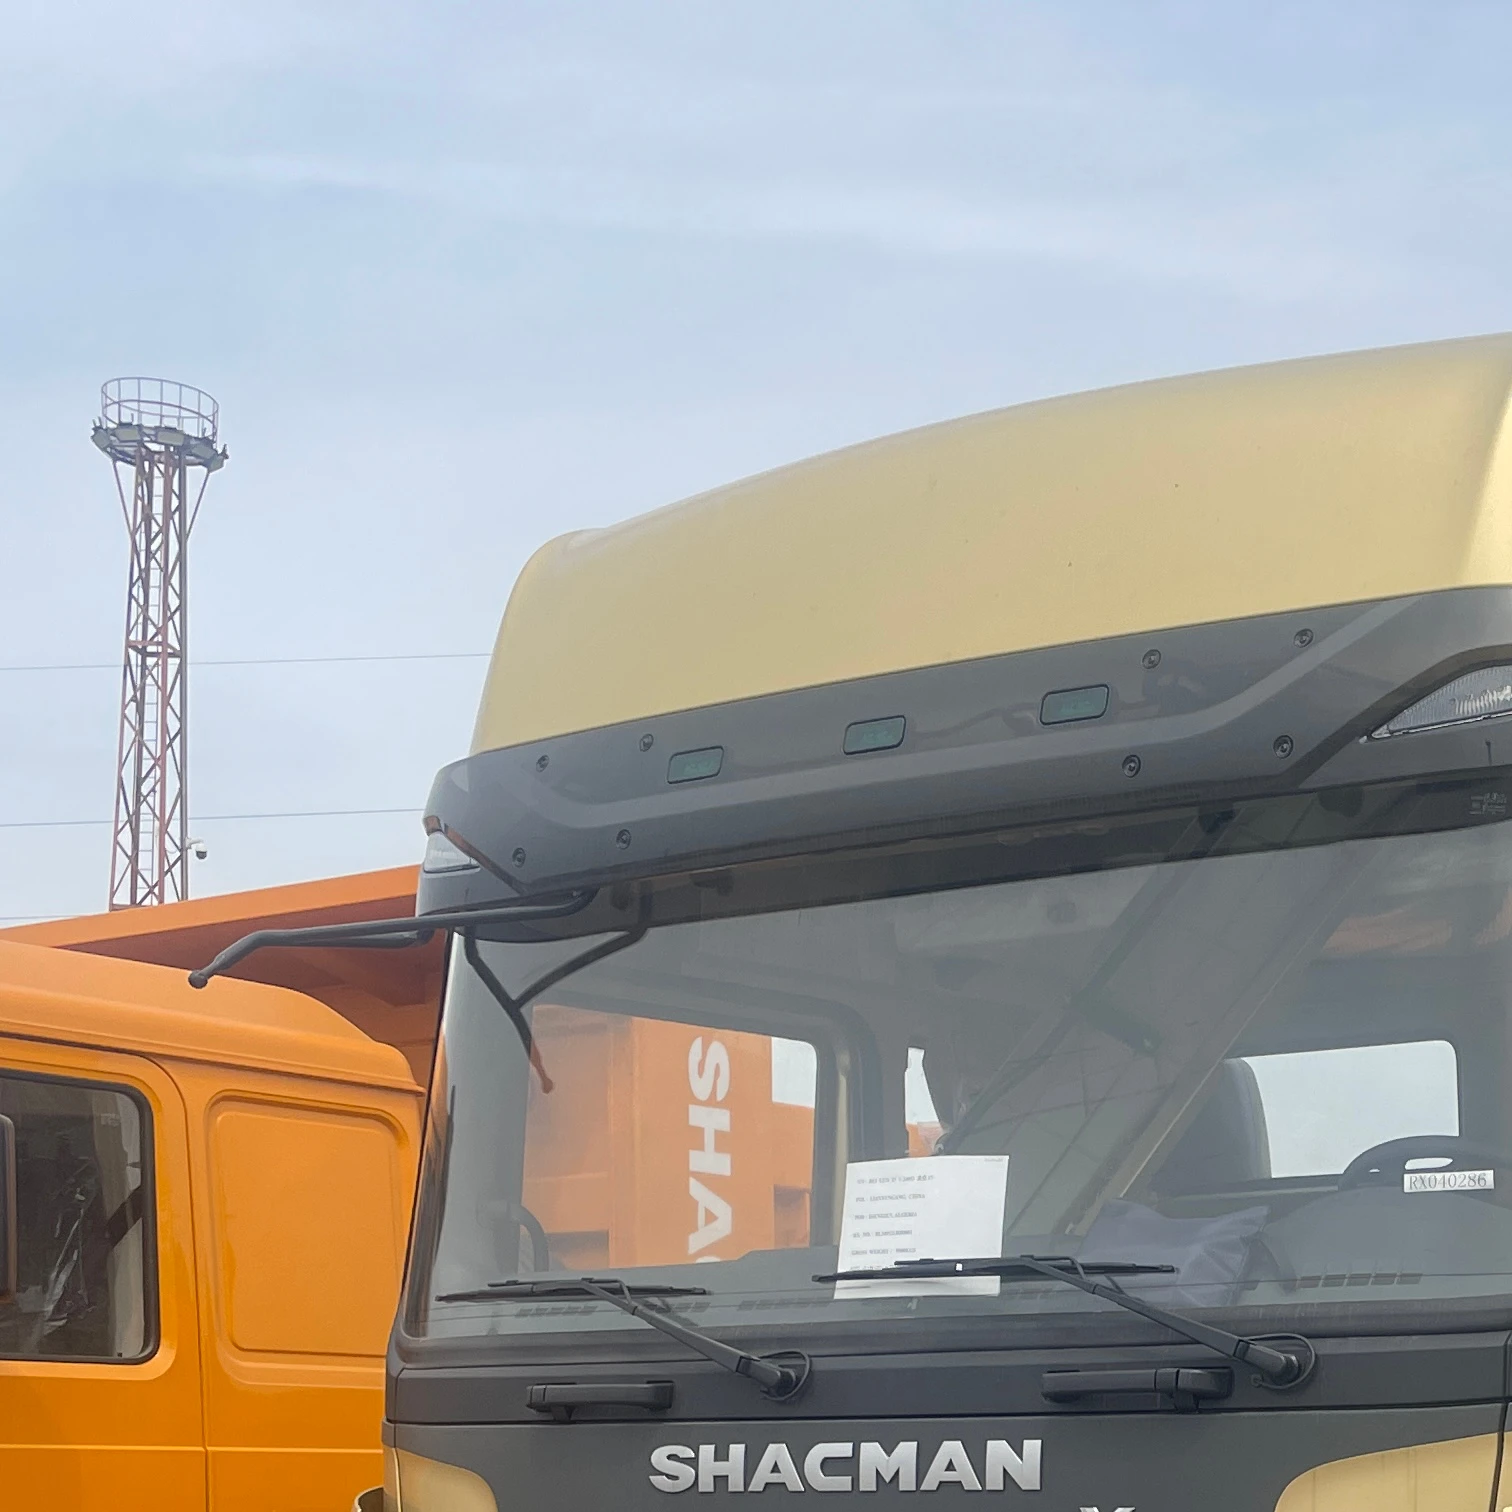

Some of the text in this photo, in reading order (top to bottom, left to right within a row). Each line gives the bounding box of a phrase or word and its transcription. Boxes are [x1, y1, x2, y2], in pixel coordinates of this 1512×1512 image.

[688, 1036, 732, 1264] SHA
[1409, 1172, 1488, 1191] RX040286
[648, 1439, 1043, 1494] SHACMAN
